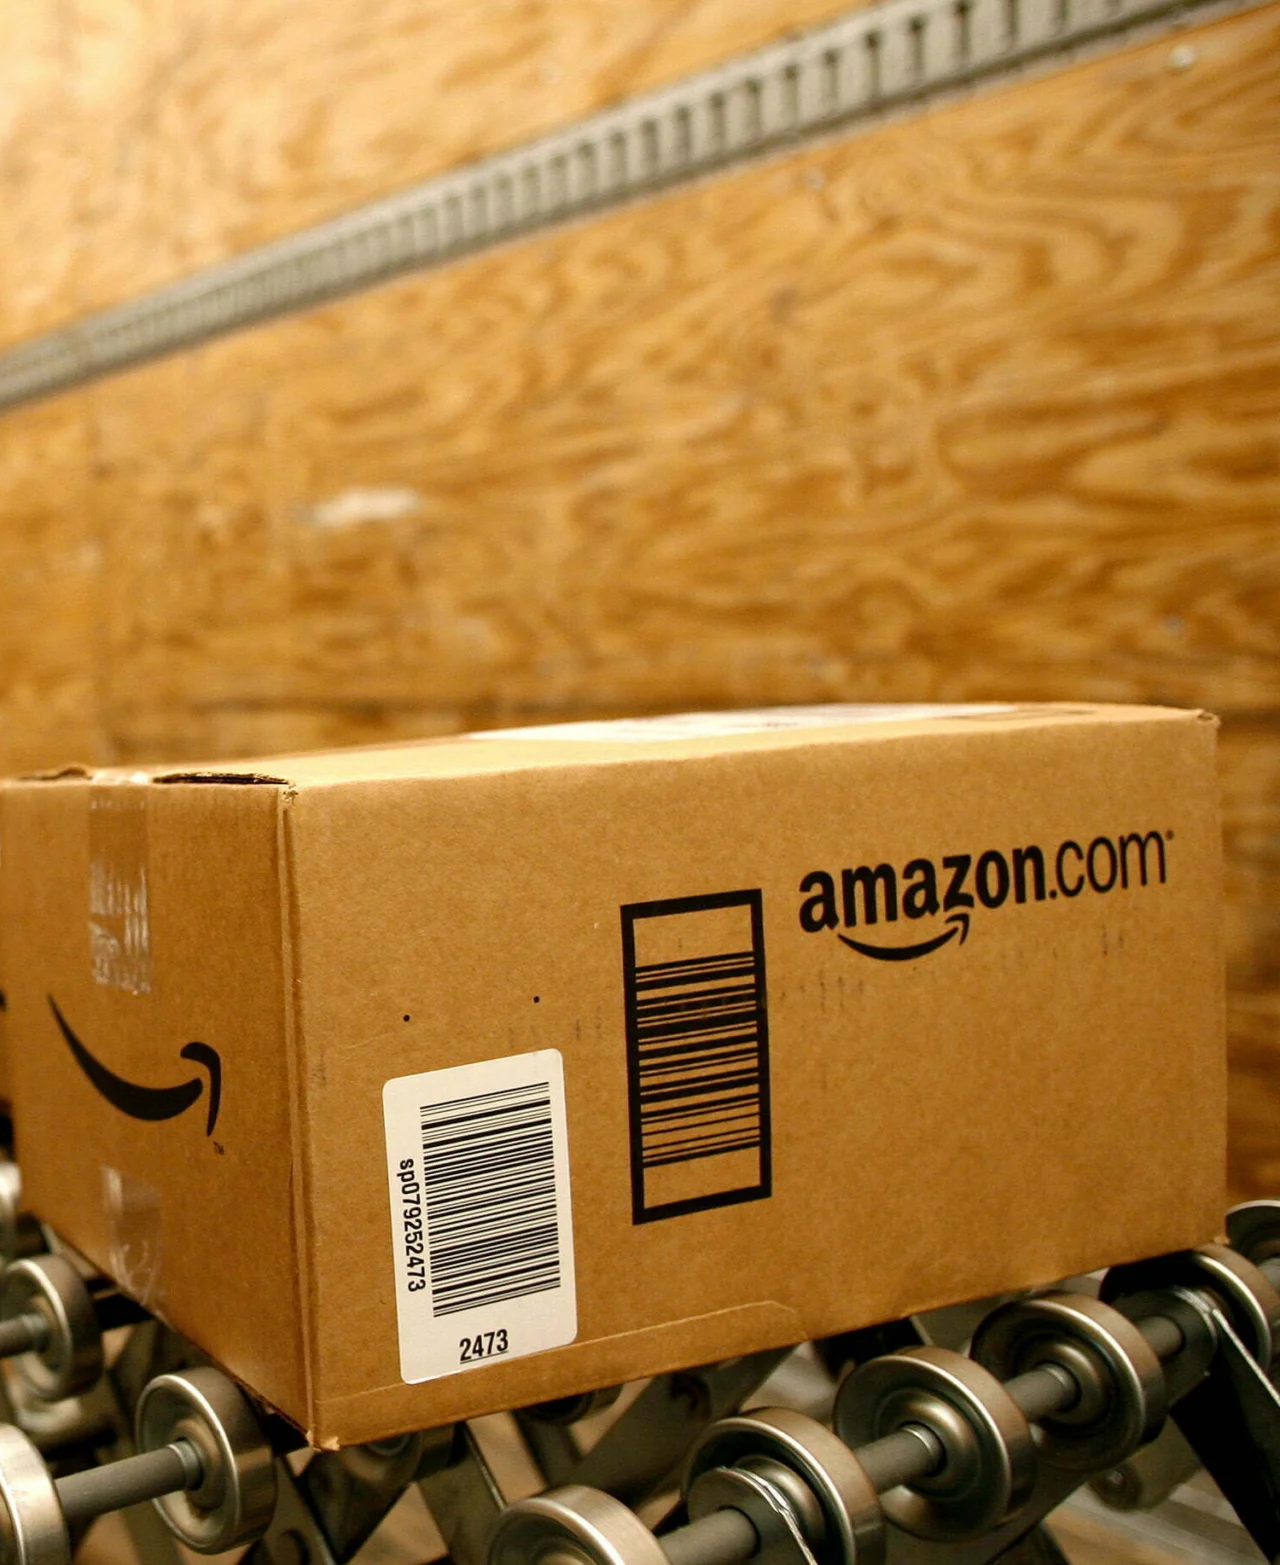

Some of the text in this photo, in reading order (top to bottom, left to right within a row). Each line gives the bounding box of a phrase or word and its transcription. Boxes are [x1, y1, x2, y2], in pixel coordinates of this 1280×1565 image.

[799, 830, 1166, 933] amazon.com
[397, 1158, 426, 1292] sp079252473
[459, 1328, 509, 1362] 2473
